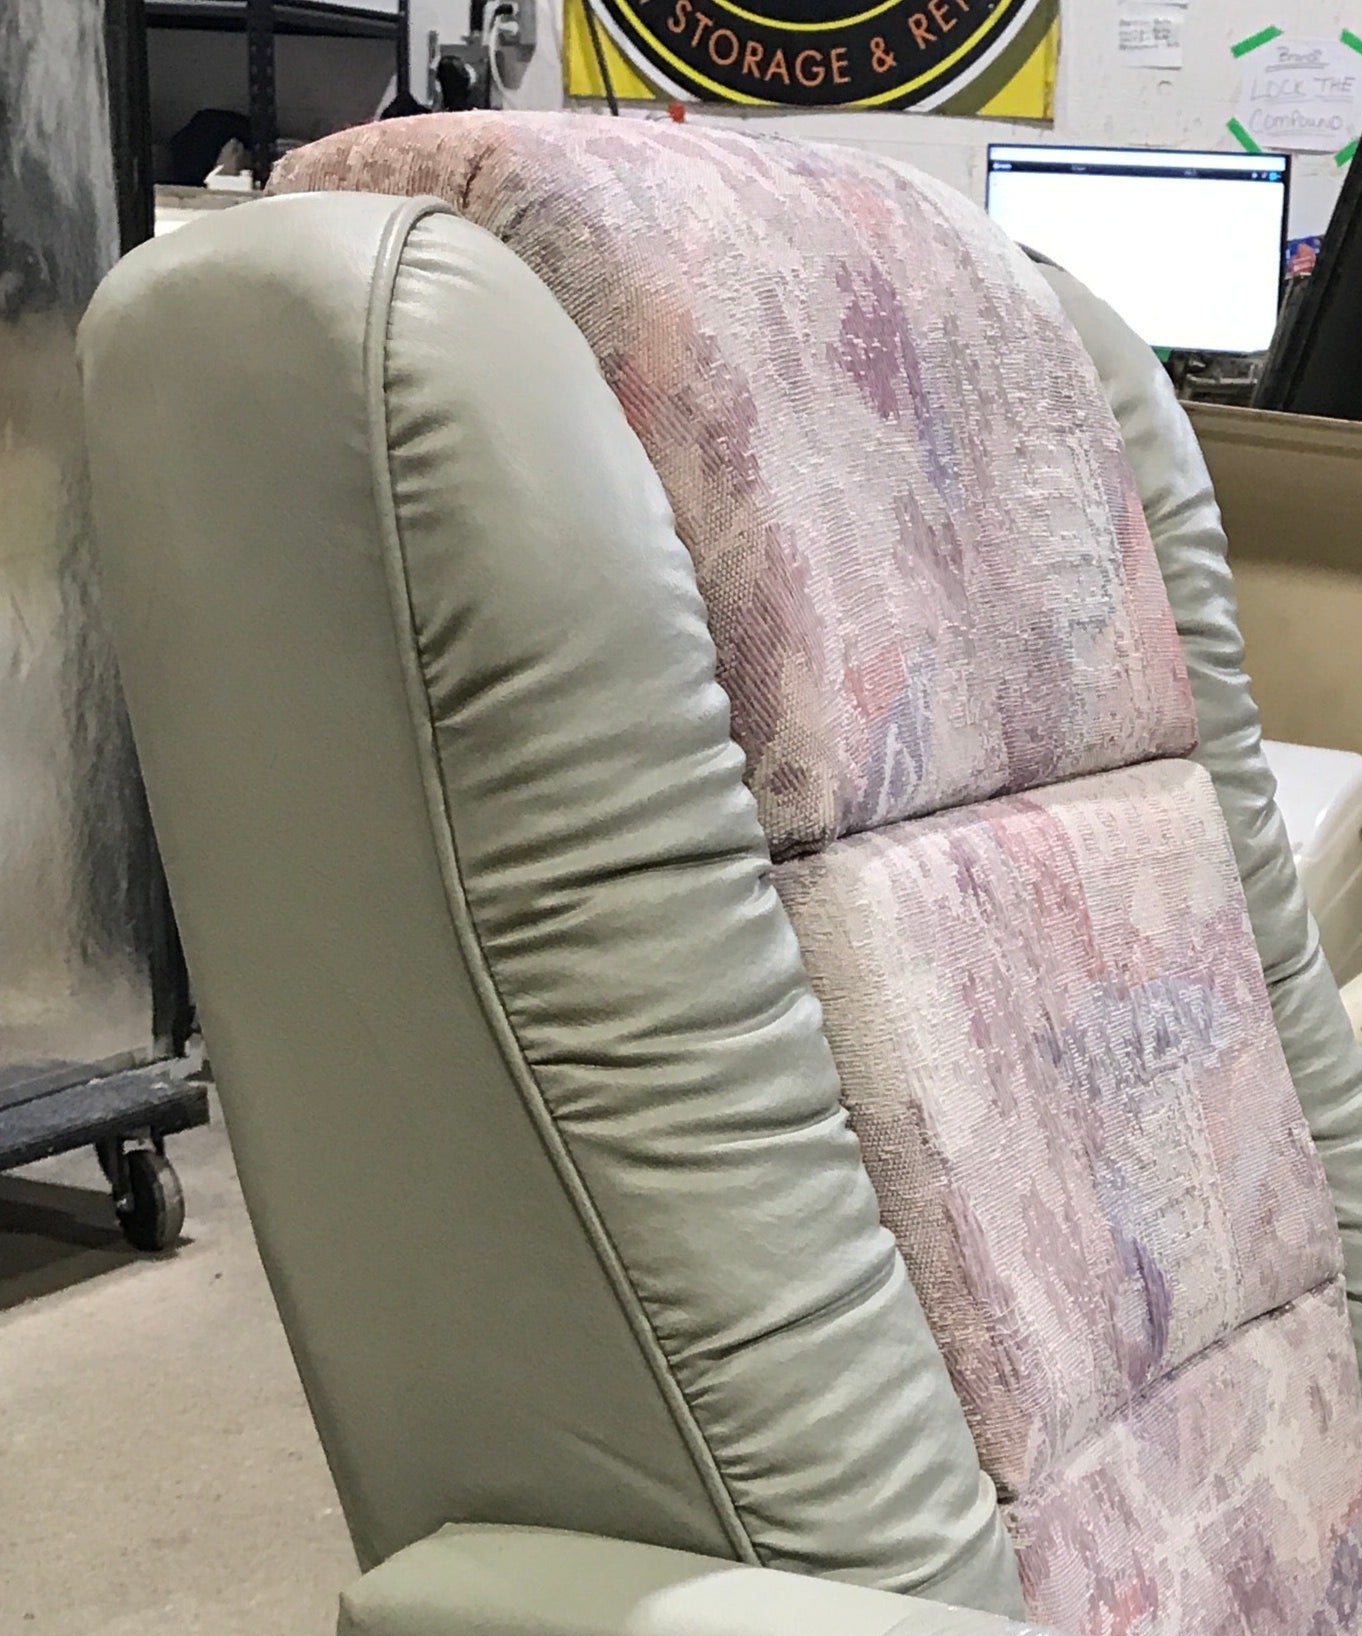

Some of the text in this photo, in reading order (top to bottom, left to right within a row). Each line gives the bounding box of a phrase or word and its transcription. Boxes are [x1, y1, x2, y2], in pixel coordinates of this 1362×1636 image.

[666, 0, 970, 87] STORAGE & RE
[1313, 76, 1356, 94] THE
